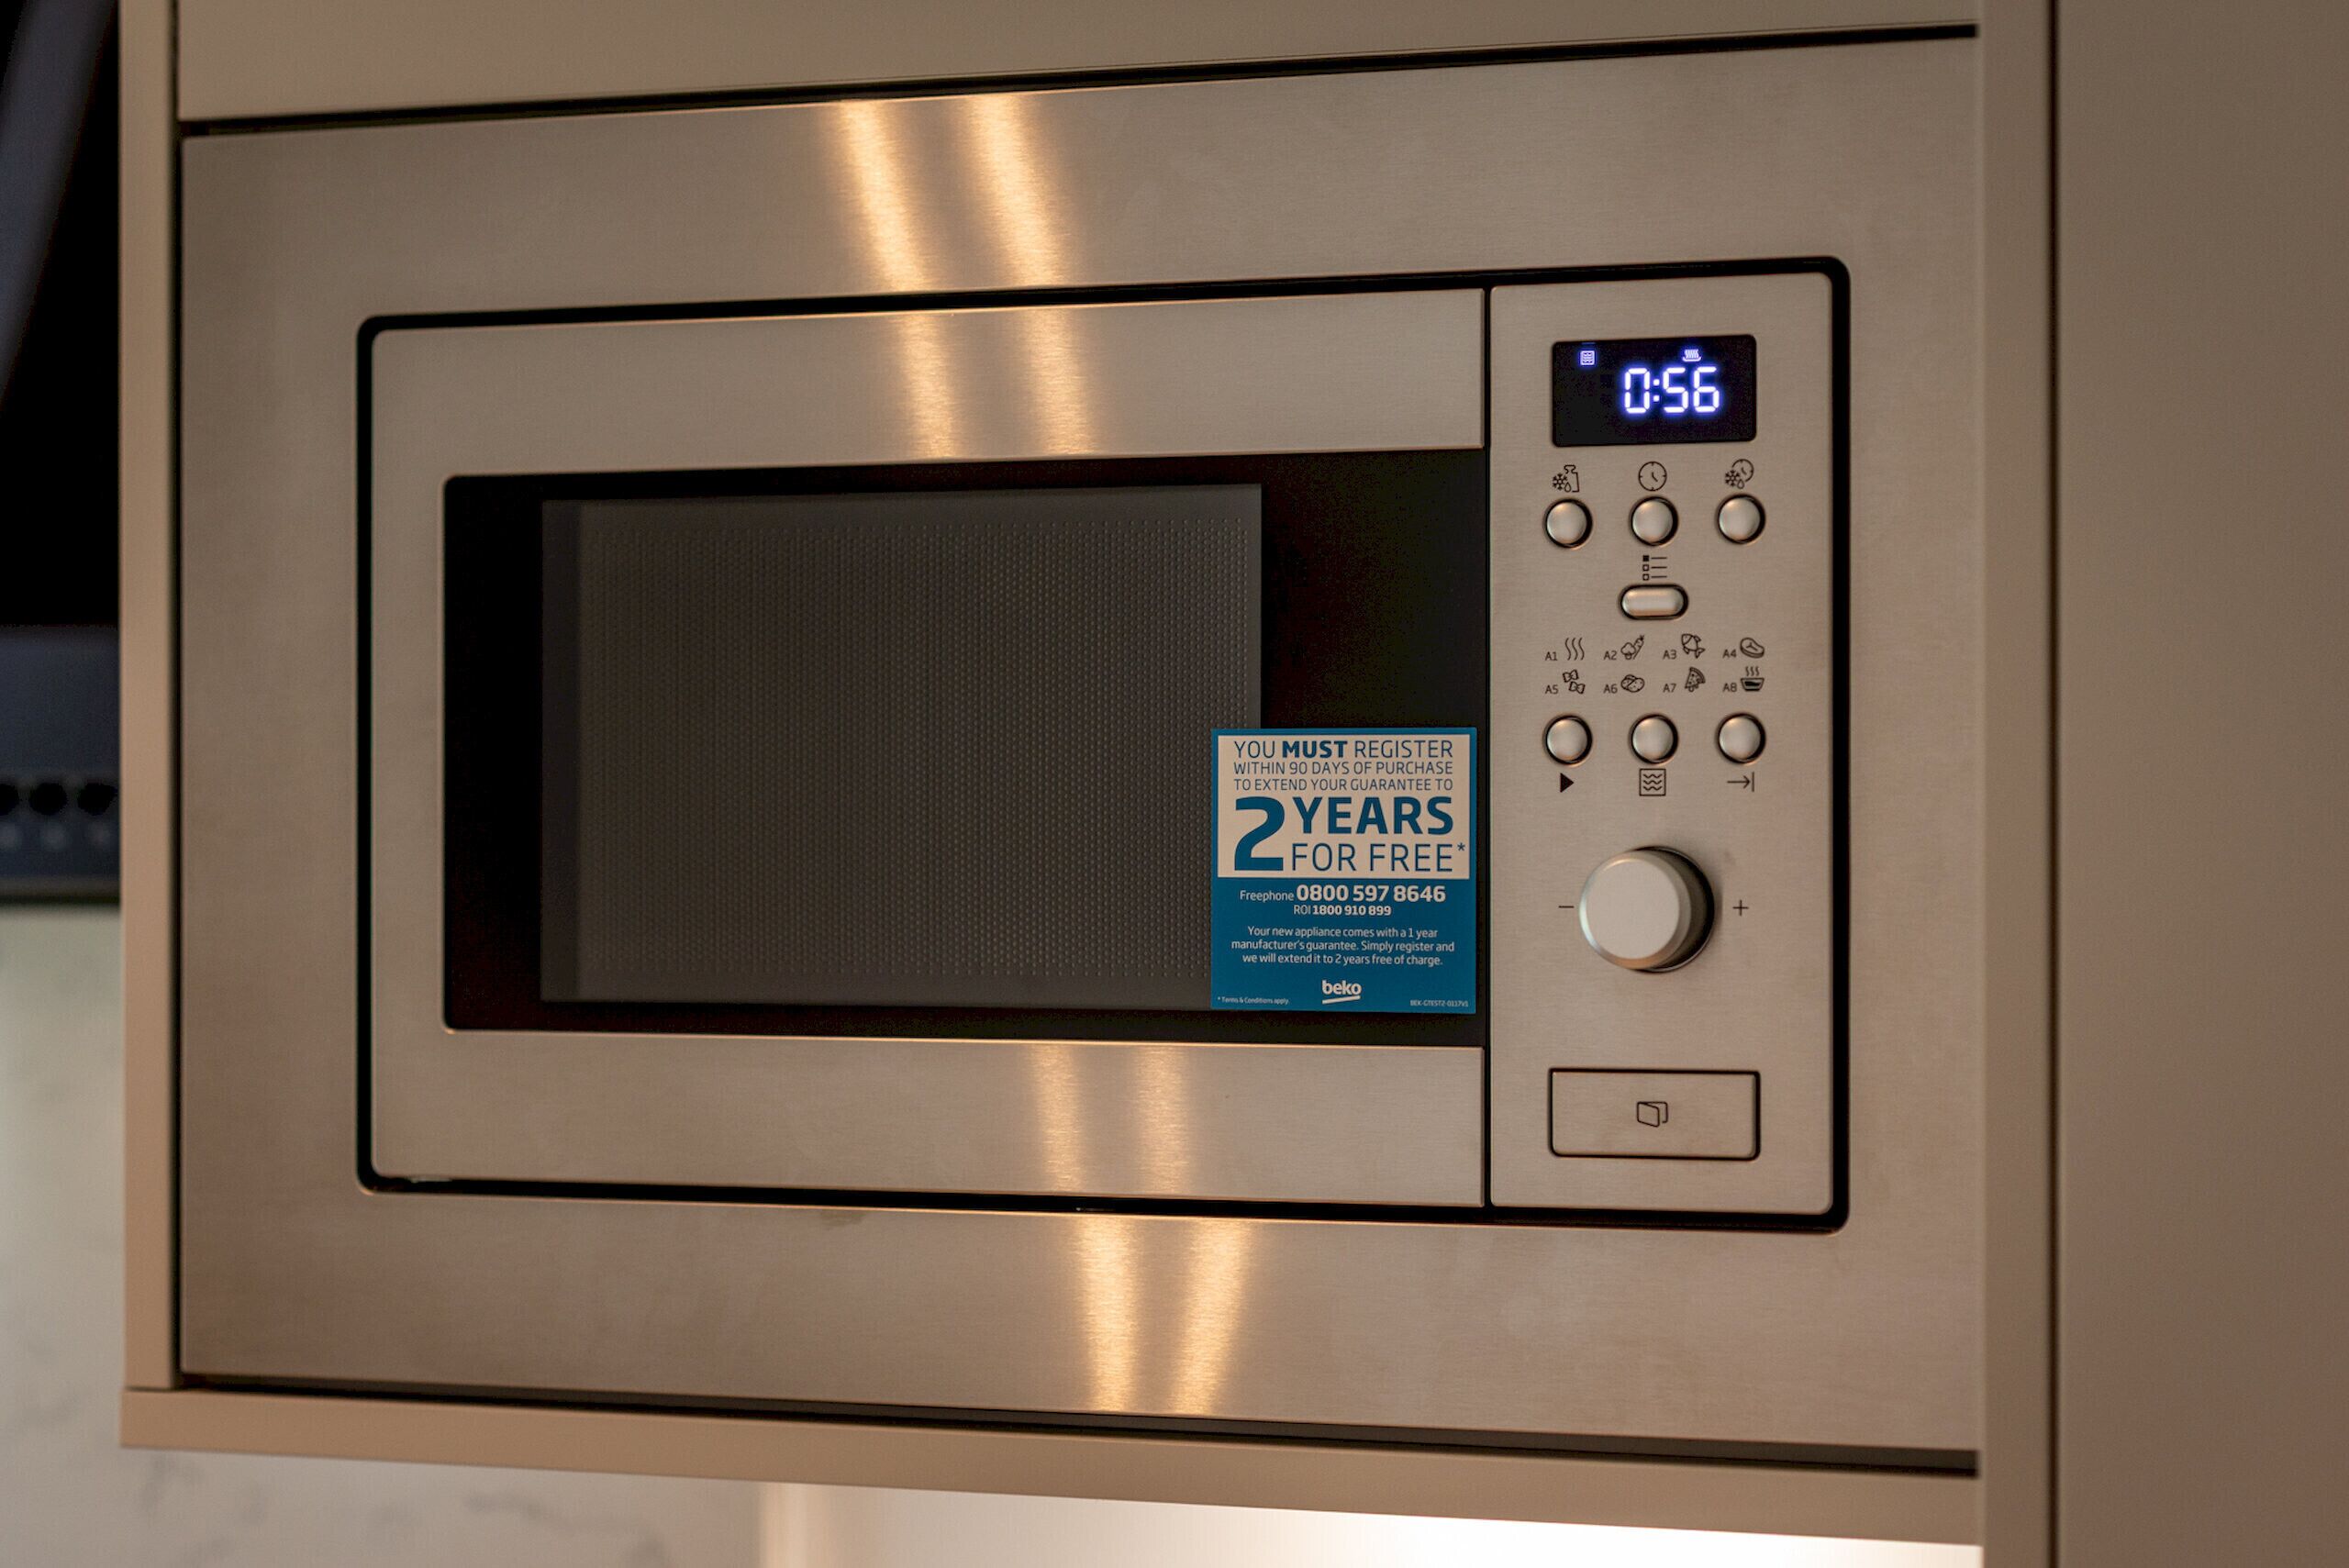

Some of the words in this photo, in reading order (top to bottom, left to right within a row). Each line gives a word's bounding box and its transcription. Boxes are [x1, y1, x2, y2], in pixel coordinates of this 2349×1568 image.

[1623, 365, 1720, 414] 0:56
[1544, 651, 1558, 662] A1
[1603, 651, 1618, 661] A2
[1663, 650, 1677, 660] A3
[1722, 649, 1737, 659] A4
[1544, 684, 1559, 695] A5
[1603, 684, 1618, 694] A6
[1663, 683, 1677, 693] A7
[1722, 683, 1738, 693] A8
[1234, 740, 1275, 759] YOU
[1282, 740, 1348, 758] MUST
[1354, 740, 1453, 758] REGISTER
[1234, 762, 1286, 774] WITHIN
[1289, 762, 1308, 774] 90
[1312, 762, 1350, 774] DAYS
[1353, 762, 1372, 774] OF
[1376, 762, 1453, 774] PURCHASE
[1234, 779, 1252, 791] TO
[1254, 779, 1308, 791] EXTEND
[1312, 779, 1347, 791] YOUR
[1351, 779, 1431, 791] GUARANTEE
[1435, 779, 1453, 791] TO
[1234, 796, 1286, 872] 2
[1292, 796, 1453, 835] YEARS
[1292, 843, 1356, 872] FOR
[1240, 890, 1295, 903] Freephone
[1296, 884, 1349, 902] 0800
[1353, 884, 1389, 902] 597
[1393, 885, 1446, 903] 8646
[1294, 905, 1311, 915] ROI
[1312, 905, 1342, 916] 1800
[1344, 906, 1366, 916] 910
[1368, 906, 1392, 917] 899
[1248, 926, 1270, 936] Your
[1272, 928, 1294, 936] new
[1295, 927, 1341, 939] appliance
[1342, 929, 1375, 938] comes
[1375, 927, 1399, 938] with
[1400, 929, 1407, 938] a
[1408, 928, 1413, 938] 1
[1416, 929, 1438, 940] year
[1231, 939, 1305, 950] manufacturer's
[1306, 940, 1359, 952] guarantee.
[1361, 940, 1394, 953] Simply
[1395, 941, 1434, 954] register
[1435, 941, 1455, 952] and
[1242, 954, 1258, 962] we
[1259, 952, 1276, 962] will
[1277, 953, 1313, 963] extend
[1313, 954, 1320, 963] it
[1323, 954, 1333, 963] to
[1335, 953, 1341, 963] 2
[1342, 955, 1371, 966] years
[1372, 954, 1392, 964] free
[1394, 954, 1405, 965] of
[1406, 955, 1443, 968] charge.
[1321, 980, 1363, 995] beko
